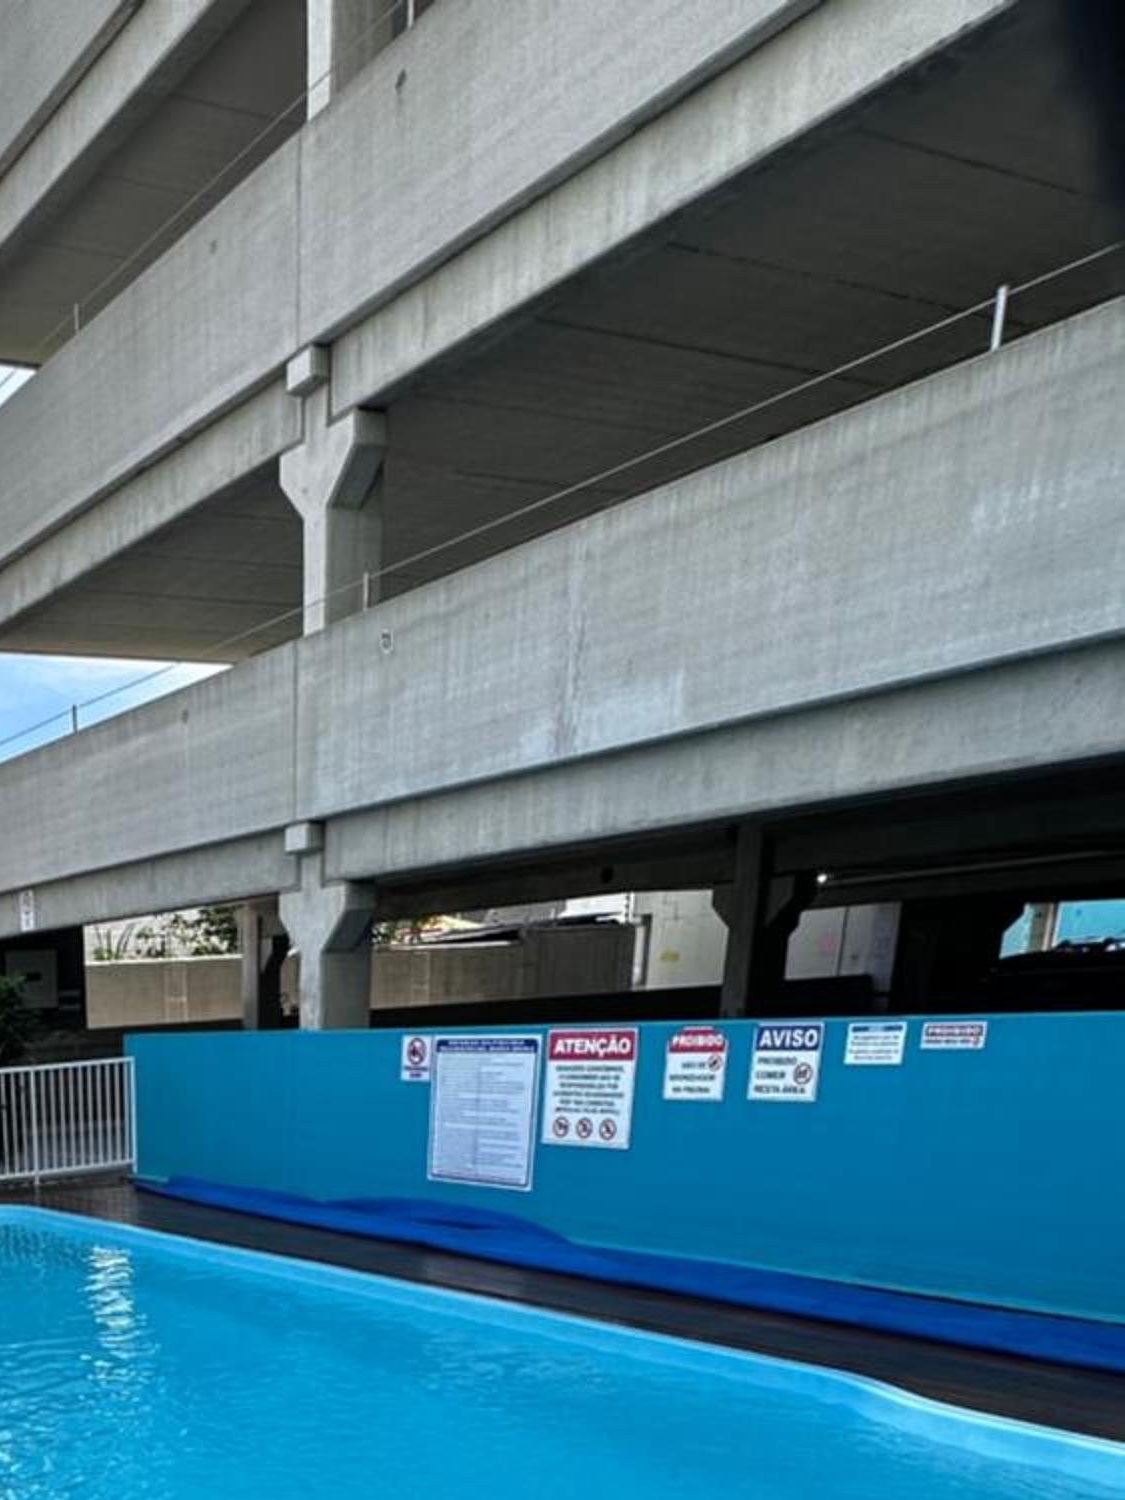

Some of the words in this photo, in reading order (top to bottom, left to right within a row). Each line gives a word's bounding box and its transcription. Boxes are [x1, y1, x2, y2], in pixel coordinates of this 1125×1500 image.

[554, 1034, 632, 1057] ATENÇÃO
[672, 1034, 723, 1046] PROIBIDO
[759, 1029, 818, 1047] AVISO
